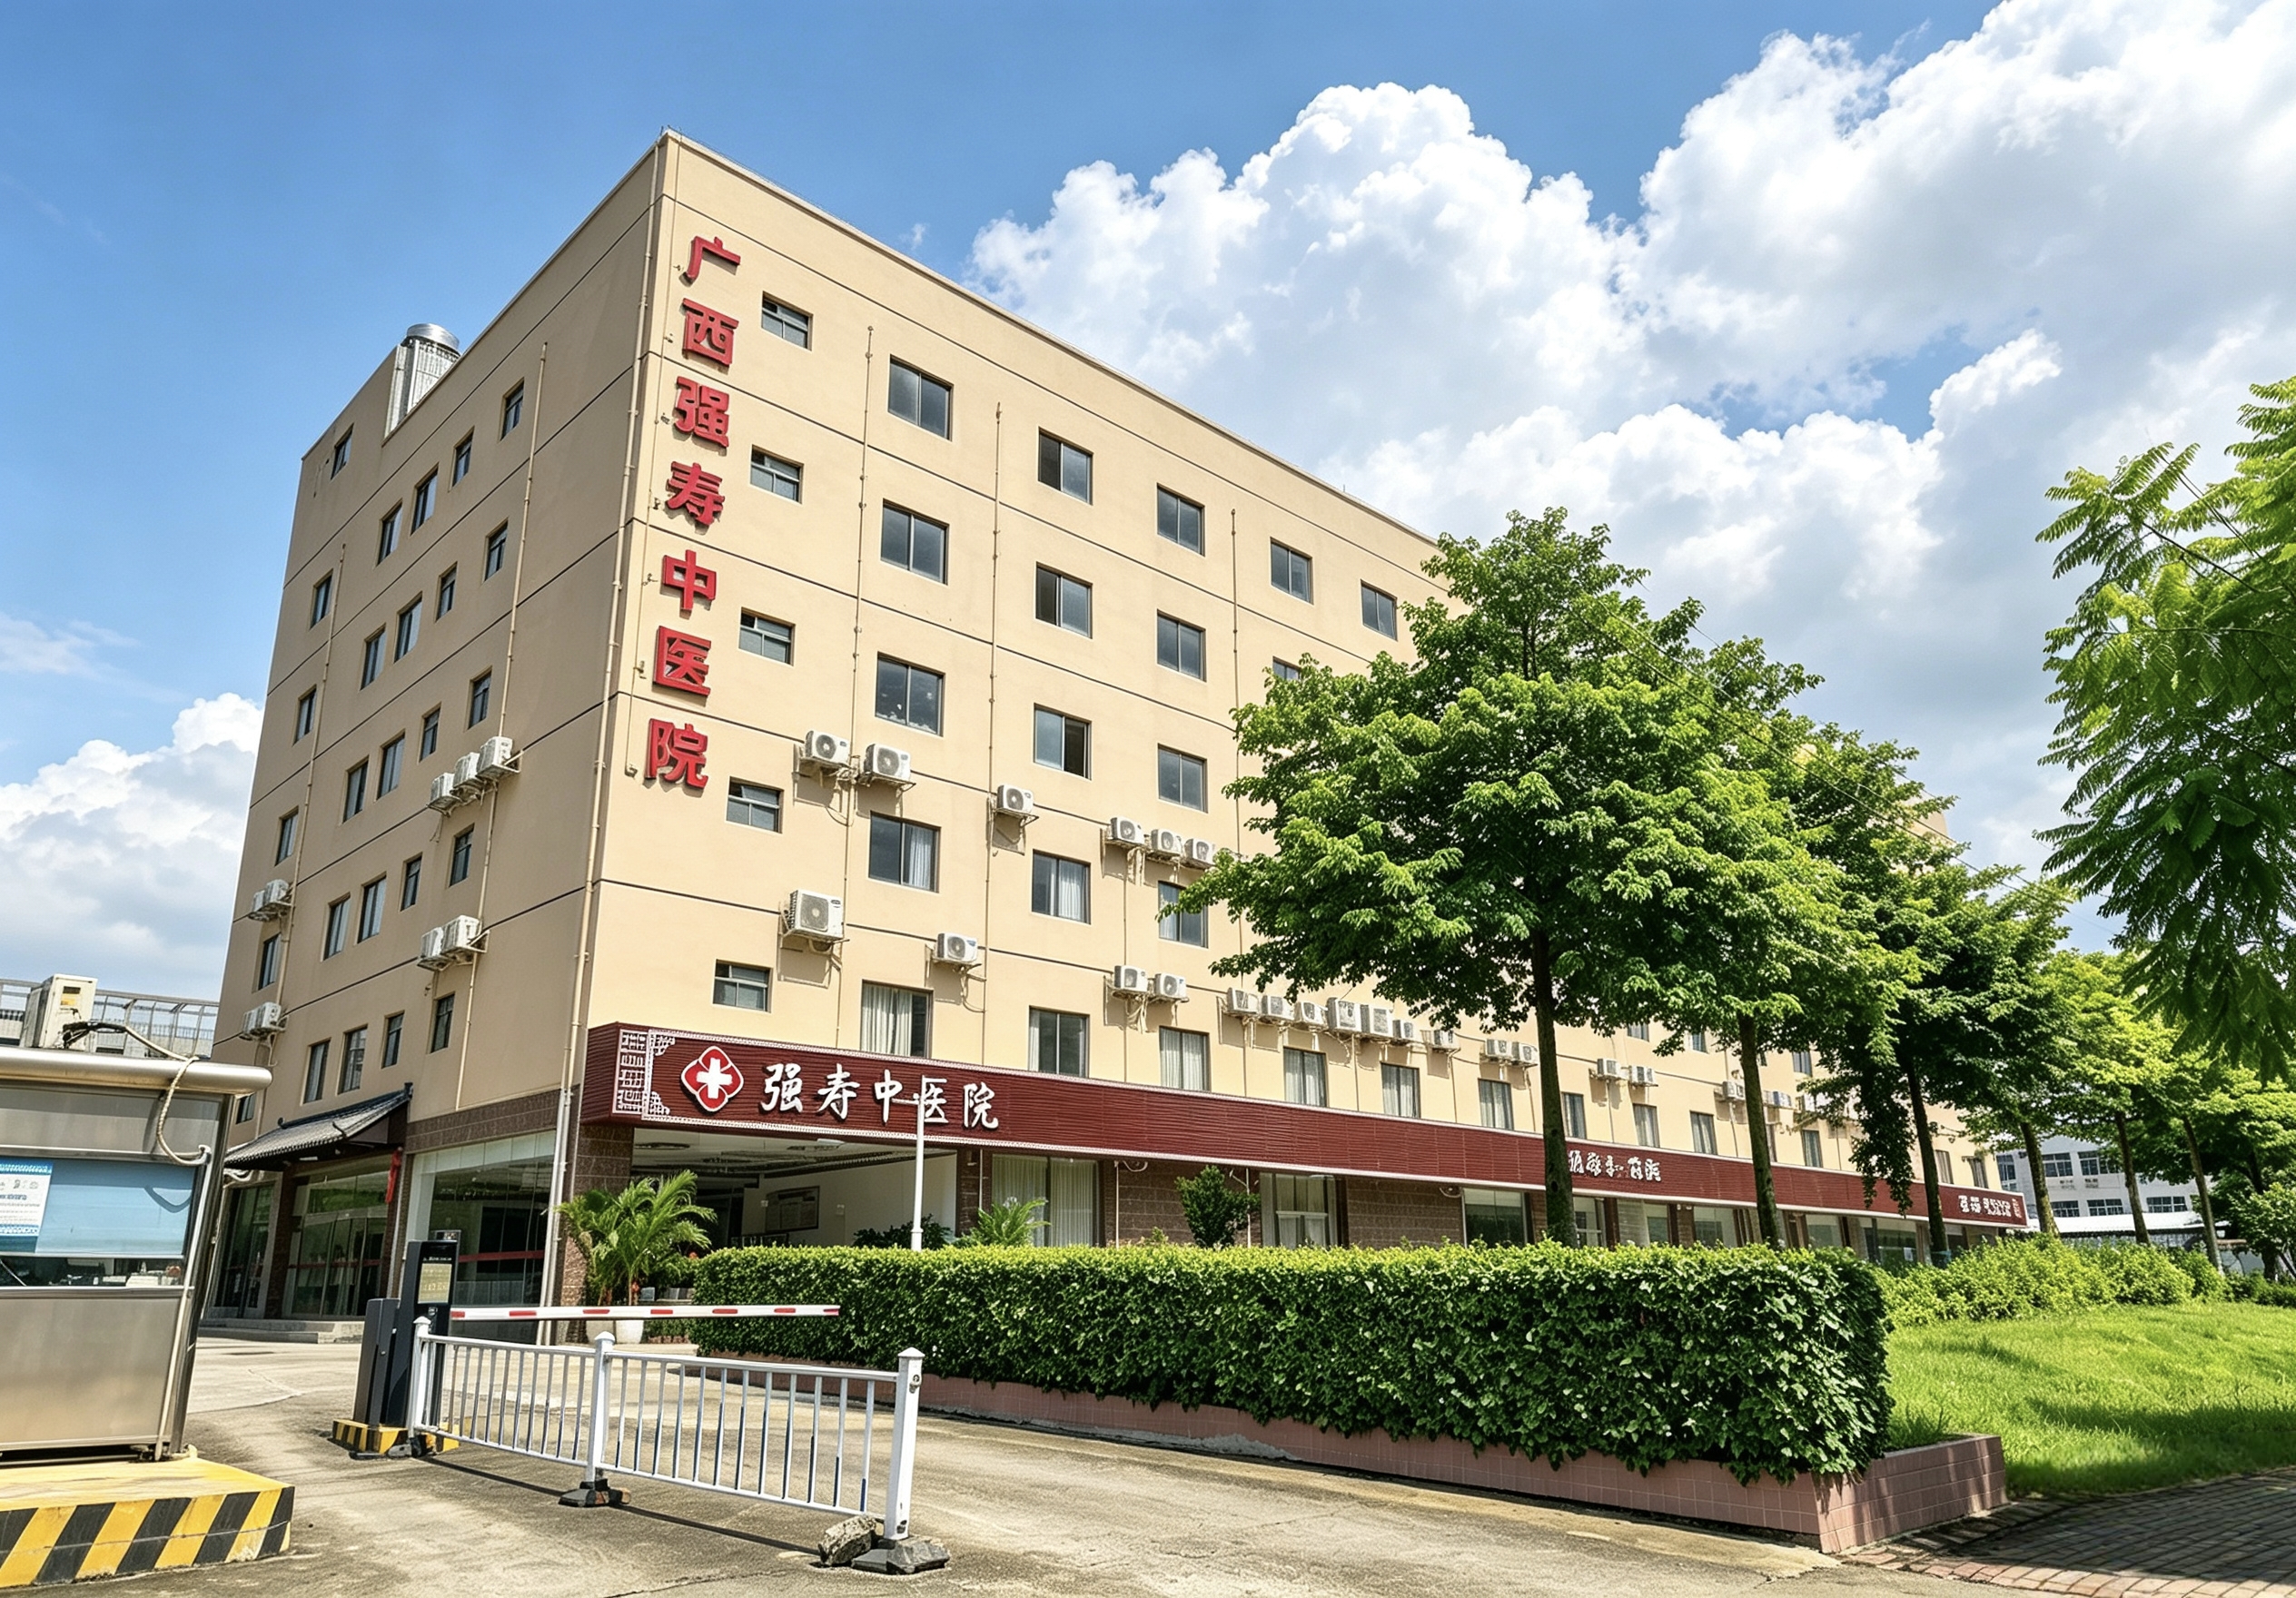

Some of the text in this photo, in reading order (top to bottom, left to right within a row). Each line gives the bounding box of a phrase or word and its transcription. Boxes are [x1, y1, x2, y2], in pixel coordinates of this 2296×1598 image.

[646, 236, 741, 790] 广西强寿中医院
[760, 1062, 999, 1129] 强寿中医院
